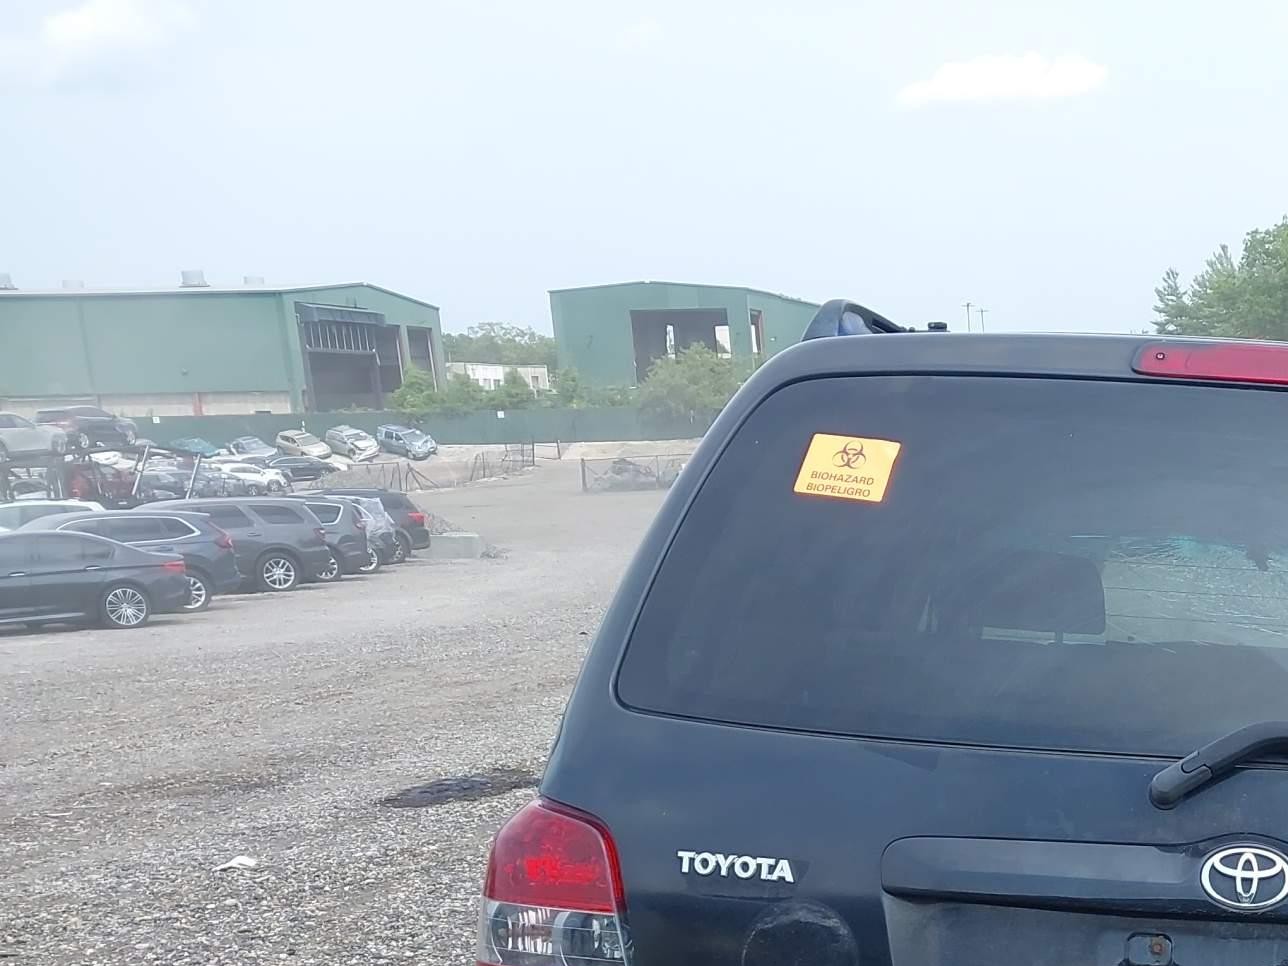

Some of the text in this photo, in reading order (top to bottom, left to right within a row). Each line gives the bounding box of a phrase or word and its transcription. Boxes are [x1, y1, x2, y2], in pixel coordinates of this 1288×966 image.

[810, 471, 875, 486] BIOHAZARD
[806, 482, 871, 498] BIOPELIGRO
[677, 850, 795, 883] TOYOTA
